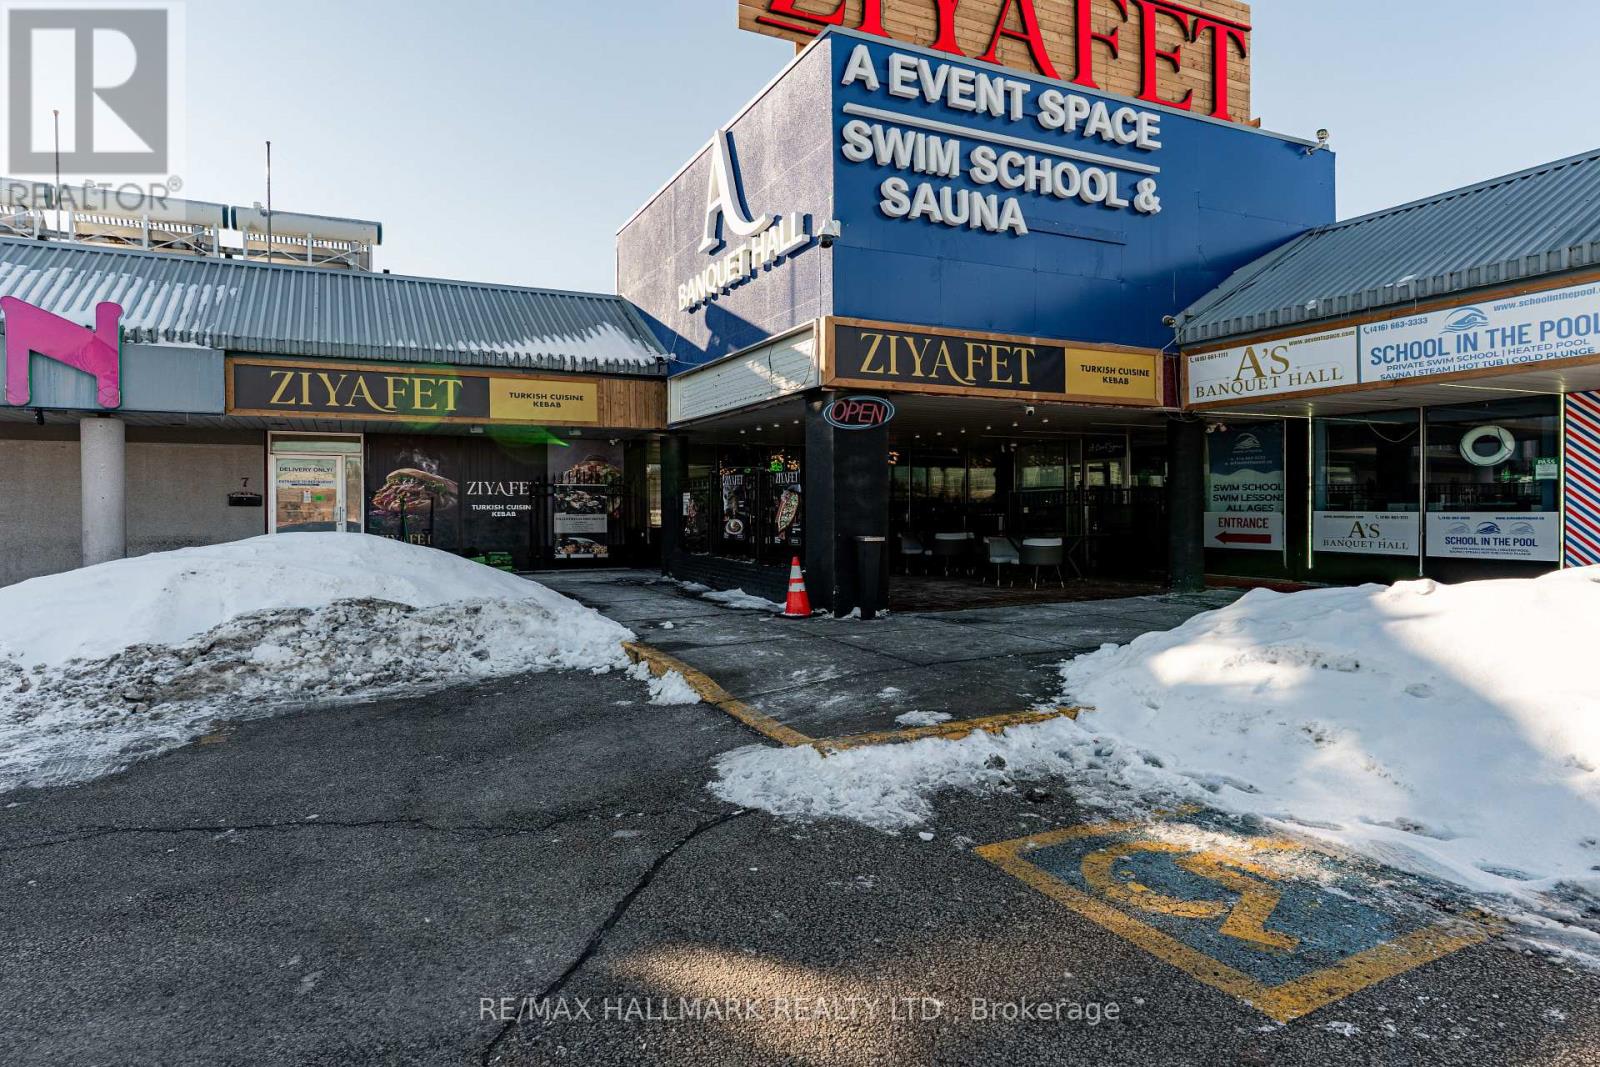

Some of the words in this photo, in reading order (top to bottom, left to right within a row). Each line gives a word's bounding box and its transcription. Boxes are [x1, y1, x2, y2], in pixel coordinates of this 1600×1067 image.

[768, 0, 1247, 121] YAFET
[841, 44, 880, 91] A
[889, 52, 1030, 121] EVENT
[1037, 89, 1161, 148] SPACE
[842, 119, 960, 178] SWIM
[970, 146, 1129, 207] SCHOOL
[1134, 178, 1162, 214] &
[697, 129, 773, 253] A
[880, 177, 1029, 236] SAUNA
[678, 244, 750, 312] BANQUET
[751, 212, 811, 271] HALL
[1371, 337, 1450, 365] SCHOOL
[1456, 331, 1478, 354] IN
[1485, 323, 1532, 349] THE
[1539, 312, 1600, 342] POOL
[860, 332, 1036, 386] ZIYAFET
[1233, 345, 1290, 382] A'S
[1380, 370, 1412, 380] SAUNA
[1417, 365, 1451, 376] STEAM
[1458, 361, 1481, 371] HOT
[1481, 358, 1504, 367] TUB
[1511, 353, 1543, 364] COLD
[1546, 346, 1596, 359] PLUNGE
[1386, 360, 1425, 371] PRIVATE
[1426, 357, 1454, 367] SWIM
[1457, 352, 1500, 362] SCHOOL
[1508, 343, 1553, 356] HEATED
[1556, 338, 1590, 349] POOL
[1080, 364, 1116, 375] TURKISH
[1118, 367, 1150, 377] CUISINE
[1103, 376, 1129, 385] KEBAB
[1195, 375, 1281, 398] BANQUET
[1288, 367, 1343, 386] HALL
[269, 370, 464, 413] ZIYAFET
[509, 391, 547, 400] TURKISH
[549, 393, 584, 401] CUISINE
[832, 400, 885, 423] OPEN
[241, 477, 250, 487] 7
[466, 481, 532, 497] ZIYAFE
[1213, 484, 1239, 492] SWIM
[1241, 482, 1286, 491] SCHOOL
[1212, 494, 1239, 502] SWIM
[1226, 504, 1244, 512] ALL
[1246, 503, 1274, 512] AGES
[1218, 517, 1269, 528] ENTRANCE
[1348, 520, 1380, 539] A'S
[1323, 539, 1374, 549] BANQUET
[1378, 541, 1409, 550] HALL
[1444, 535, 1479, 546] SCHOOL
[1481, 536, 1490, 546] IN
[1493, 537, 1511, 547] THE
[1513, 537, 1538, 547] POOL
